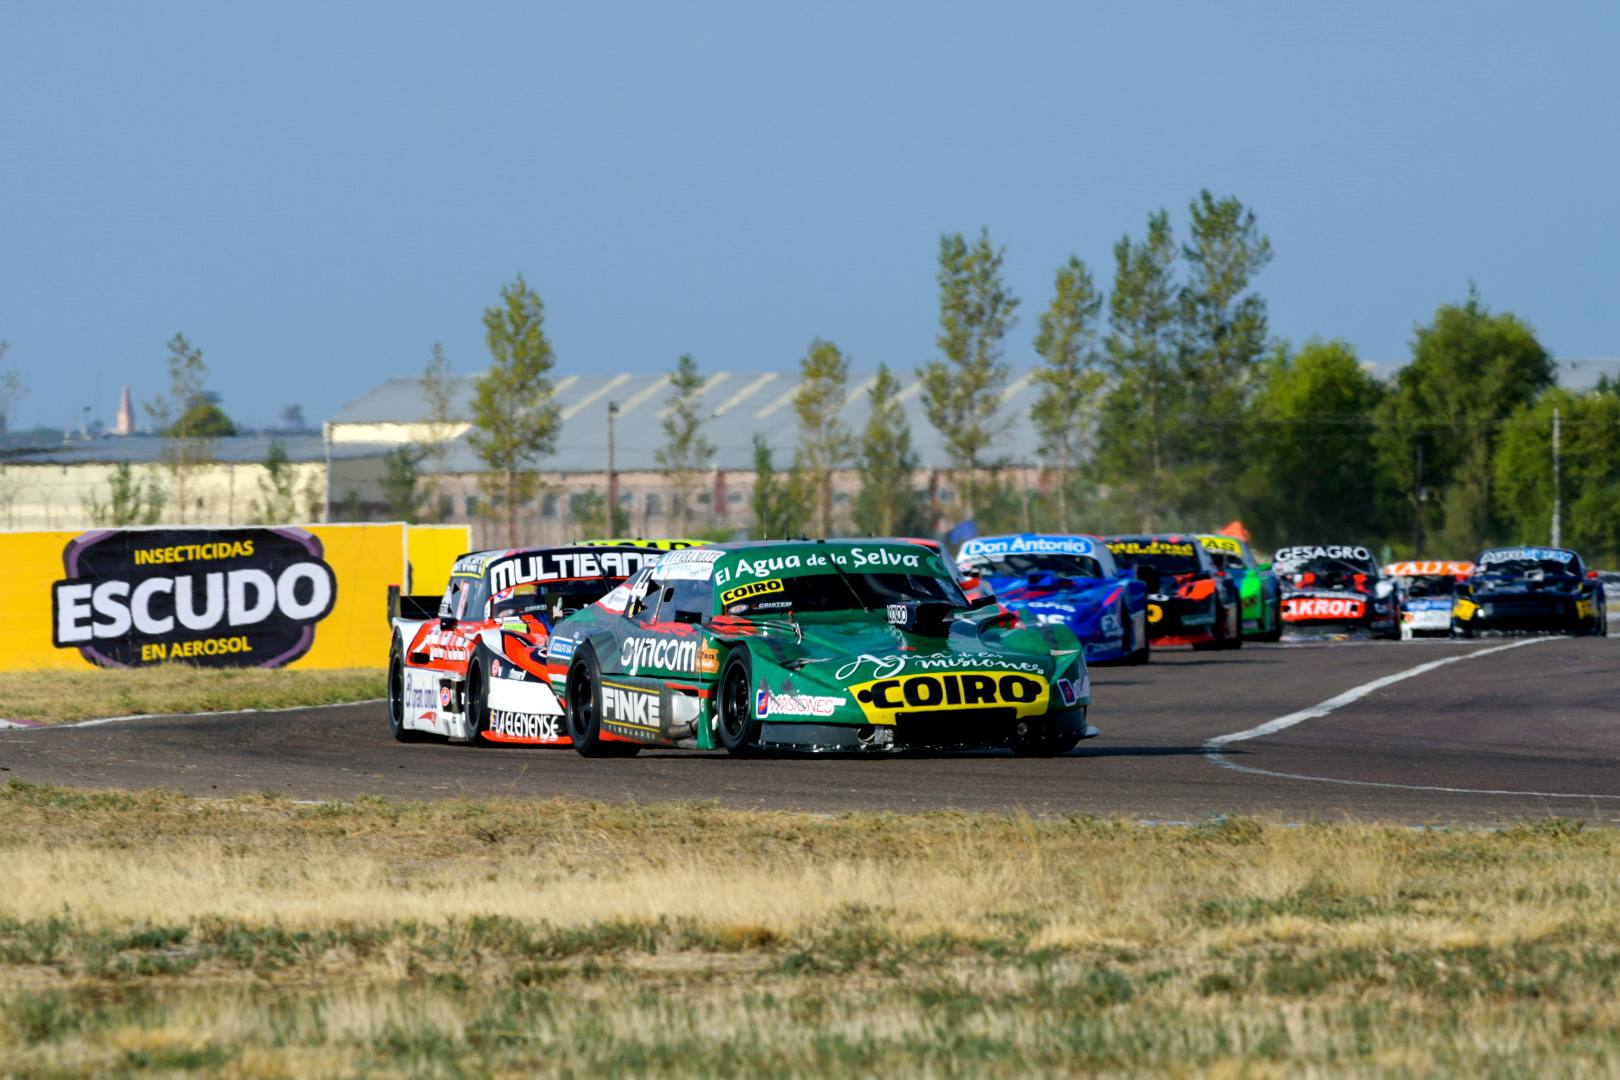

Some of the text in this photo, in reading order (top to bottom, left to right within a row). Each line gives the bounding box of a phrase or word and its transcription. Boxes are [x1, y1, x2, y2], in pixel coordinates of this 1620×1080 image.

[134, 540, 254, 565] INSECTICIDAS
[970, 537, 1086, 555] Don Antonio
[1275, 545, 1370, 562] GESAGRO
[714, 567, 731, 587] El
[735, 553, 801, 577] Agua
[806, 554, 826, 567] de
[830, 553, 847, 565] la
[850, 547, 919, 568] Selva
[57, 562, 332, 642] ESCUDO
[722, 581, 782, 602] COIRO
[141, 636, 253, 661] EN AEROSOL
[866, 675, 1040, 709] COIRO
[601, 687, 661, 728] FINKE
